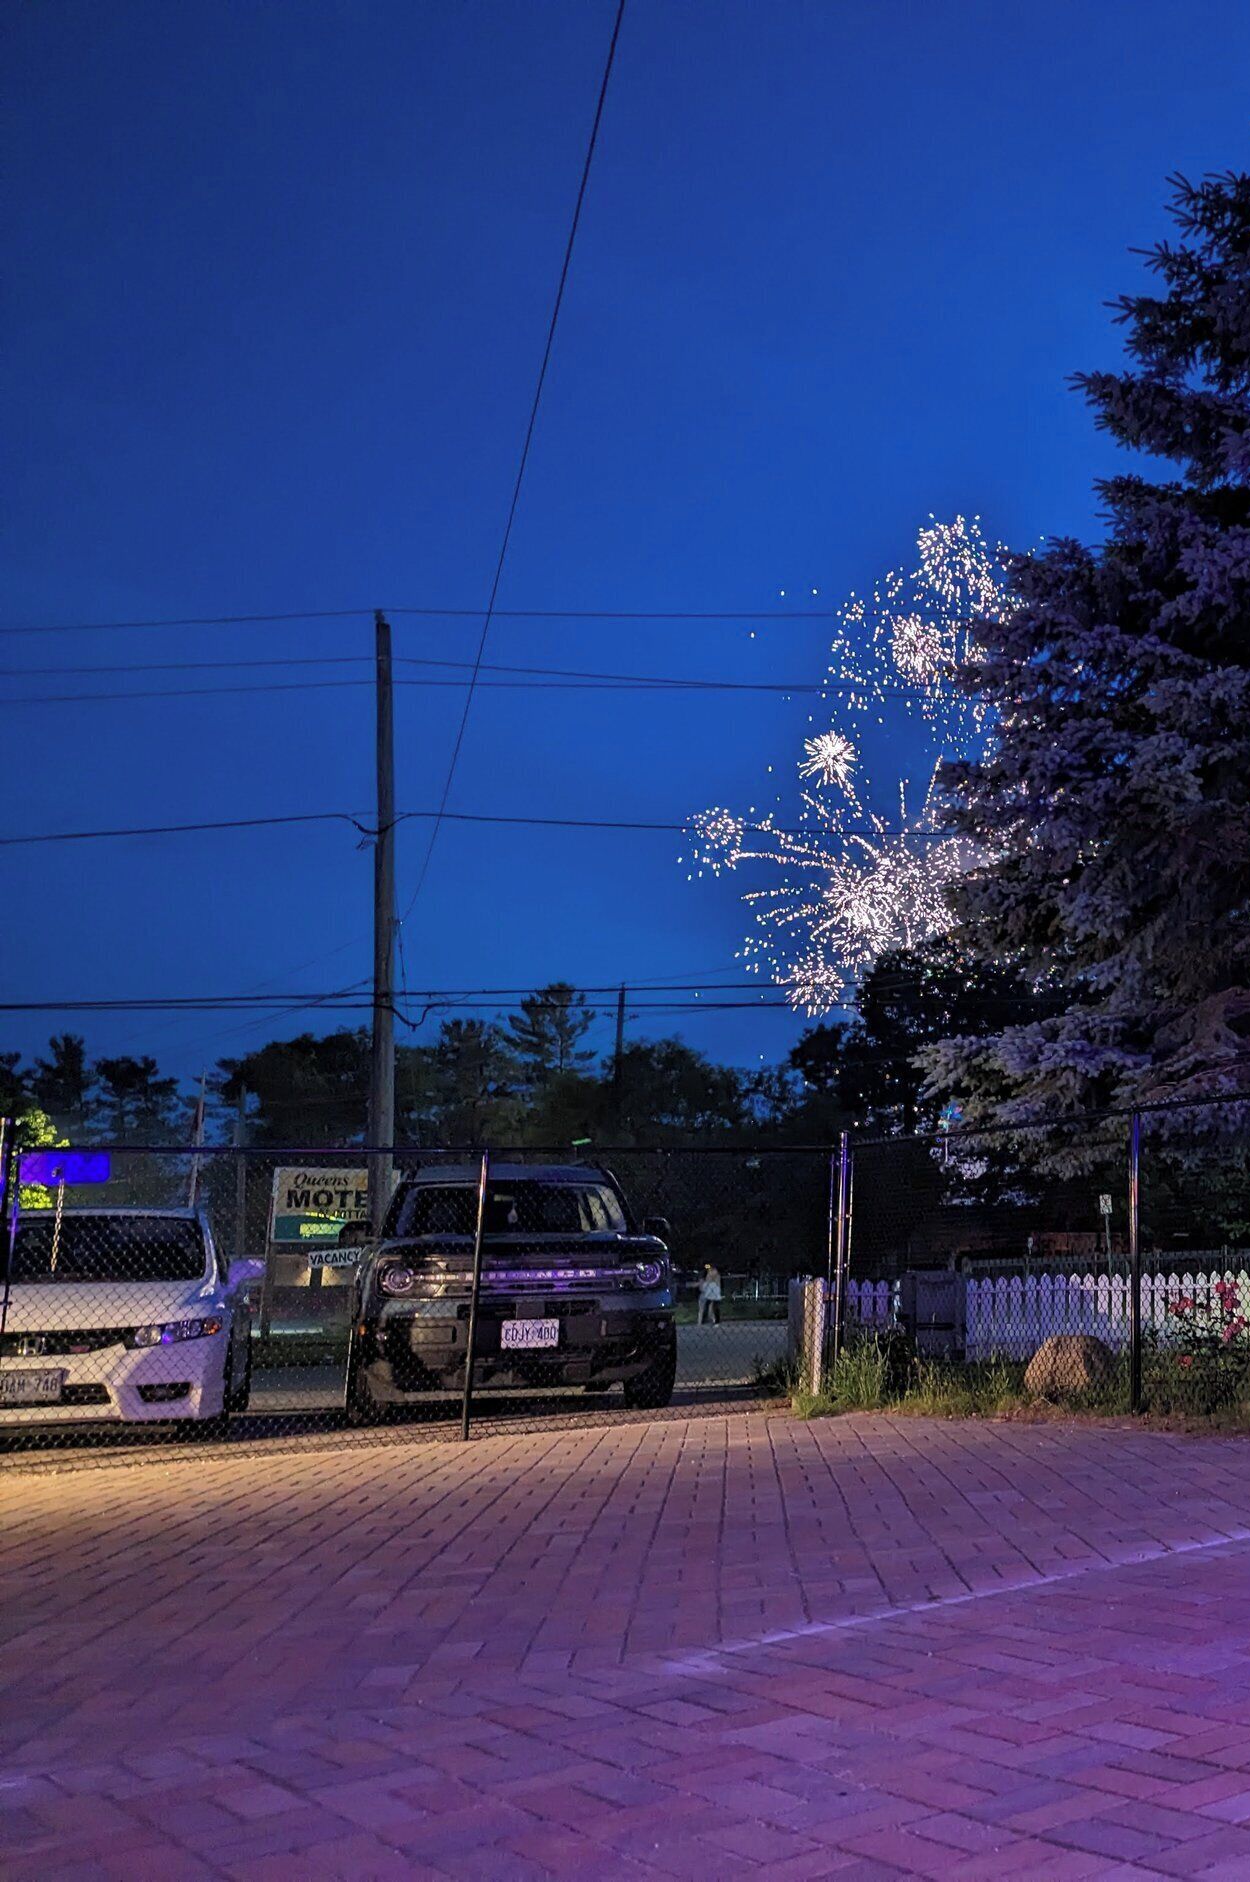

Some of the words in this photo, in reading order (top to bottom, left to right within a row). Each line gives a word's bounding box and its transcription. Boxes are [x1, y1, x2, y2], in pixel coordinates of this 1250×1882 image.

[293, 1172, 349, 1189] Queens
[286, 1189, 368, 1209] MOTE
[310, 1251, 360, 1265] VACANCY
